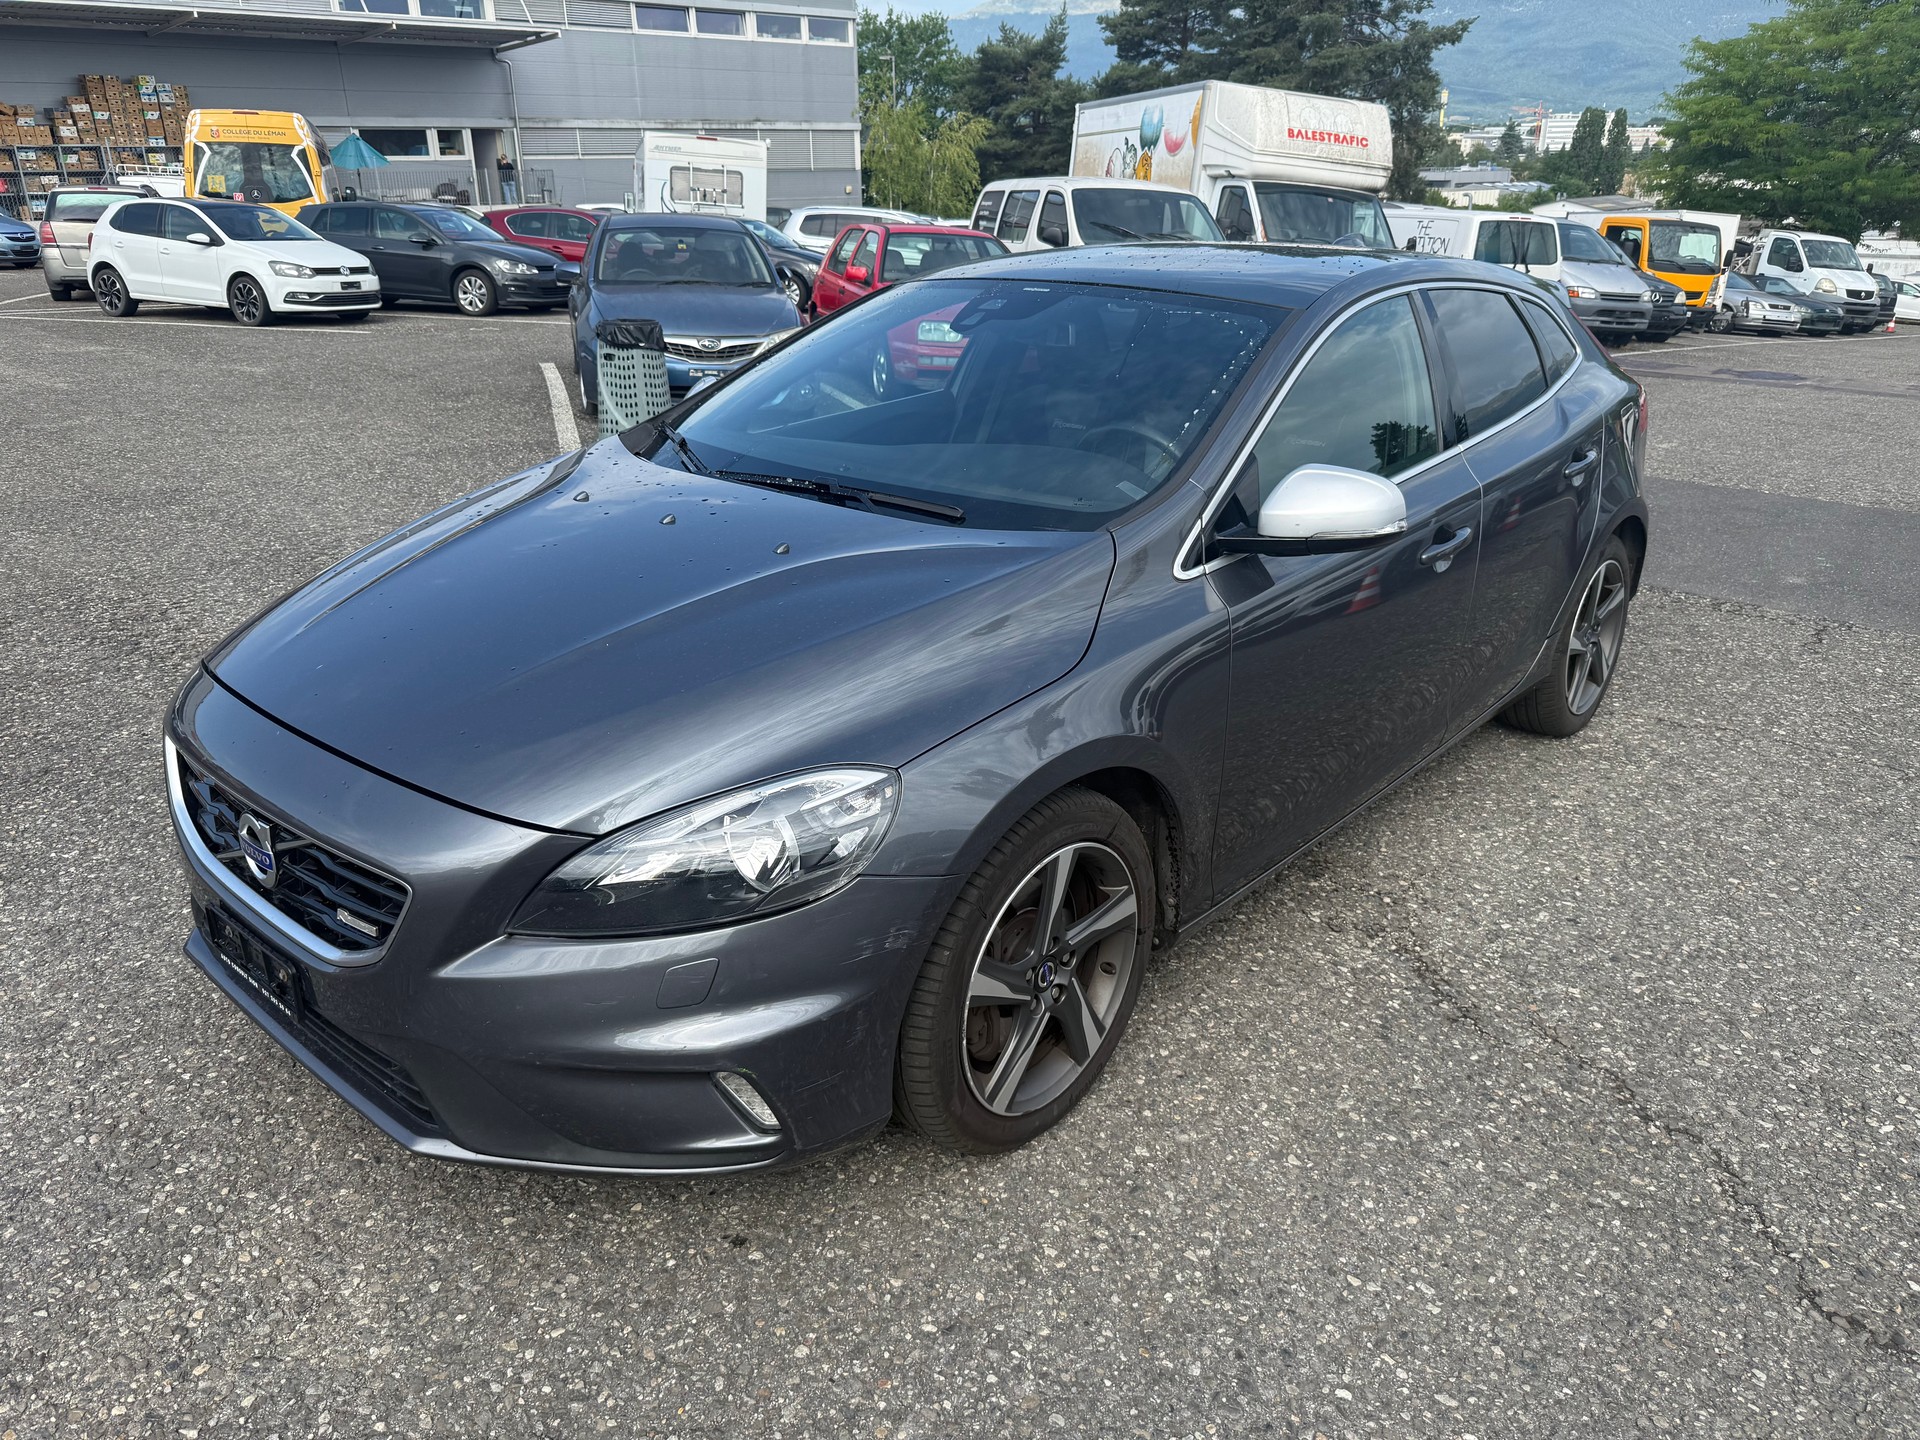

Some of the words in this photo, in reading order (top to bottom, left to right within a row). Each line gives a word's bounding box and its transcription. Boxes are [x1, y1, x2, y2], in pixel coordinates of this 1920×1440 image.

[1287, 127, 1369, 148] BALESTRAFIC
[1417, 220, 1435, 236] THE
[241, 841, 270, 865] VOLVO
